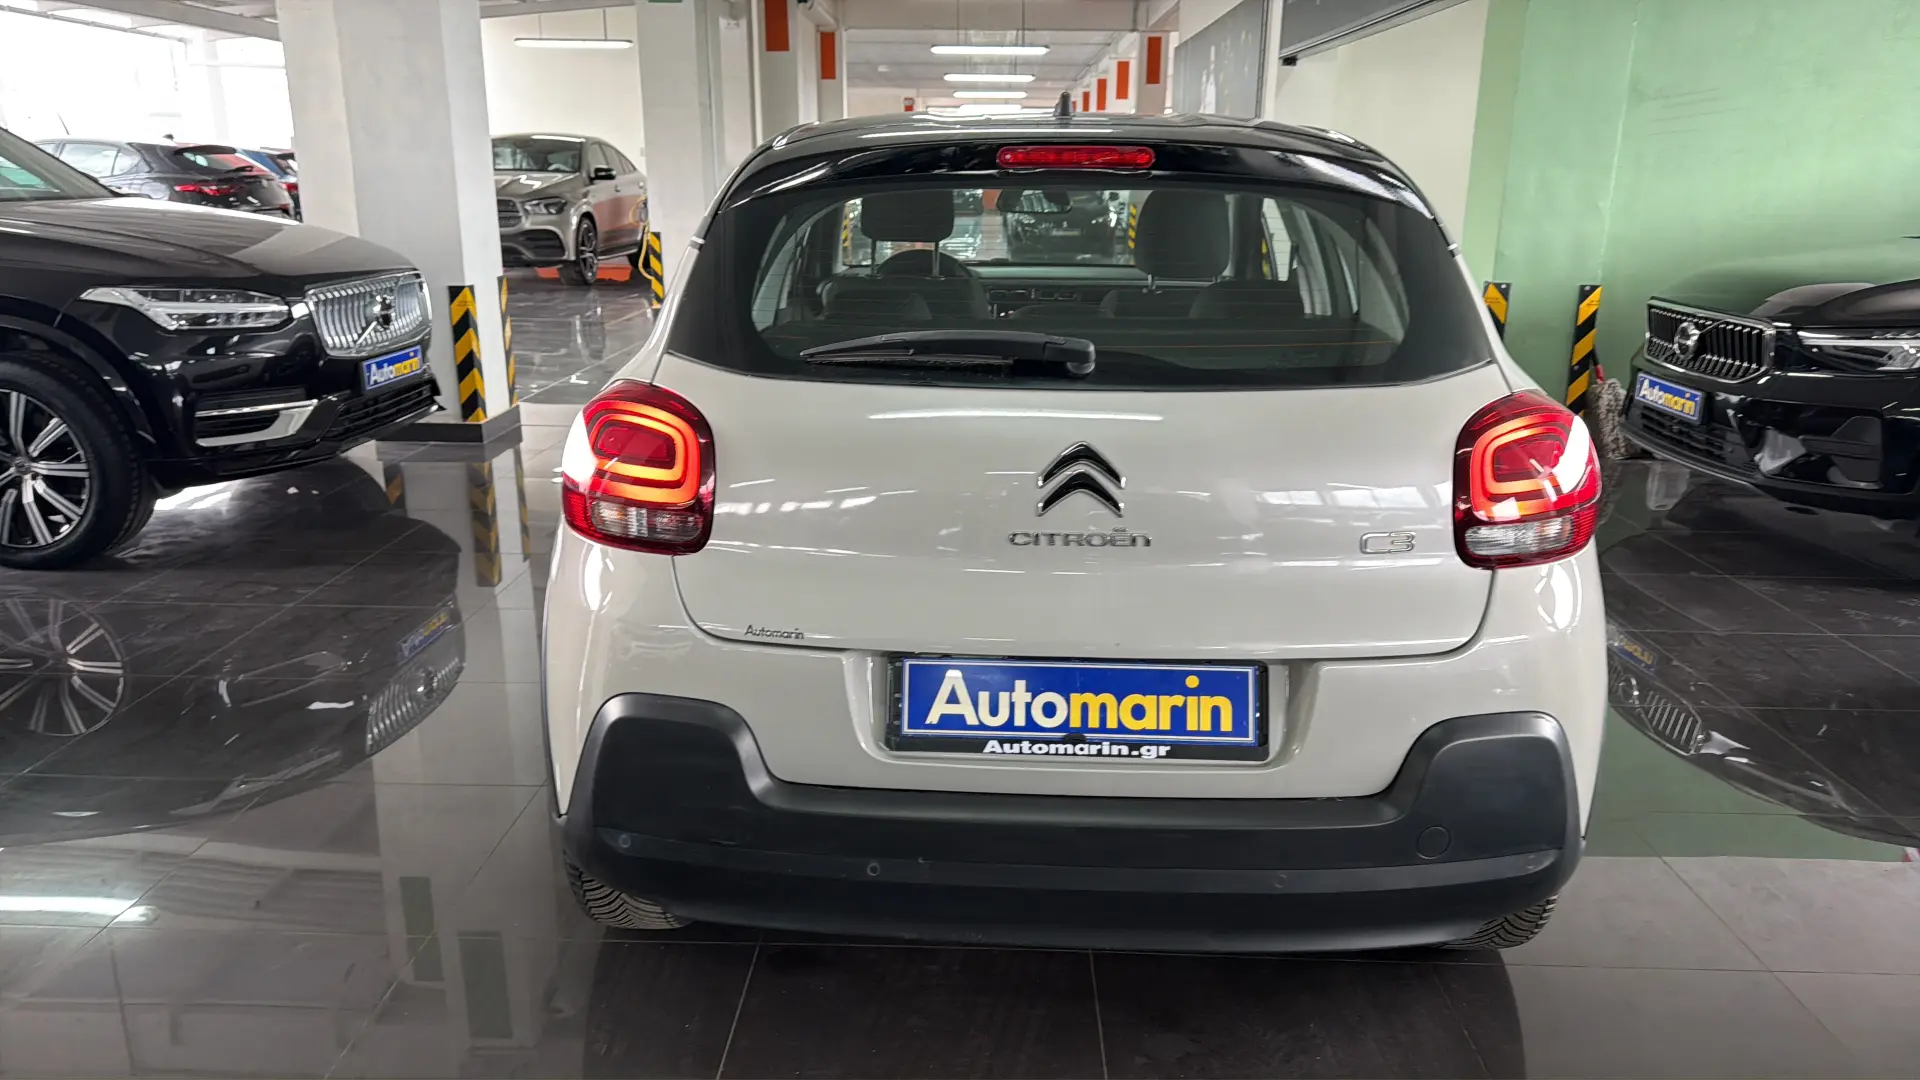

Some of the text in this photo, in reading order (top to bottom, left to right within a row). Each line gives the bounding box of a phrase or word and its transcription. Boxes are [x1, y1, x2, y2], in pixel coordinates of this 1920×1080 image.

[369, 351, 419, 386] Automarin
[1639, 378, 1696, 416] Automarin
[1359, 531, 1415, 555] C3
[744, 624, 805, 640] Automarin
[924, 669, 1234, 732] Automarin
[982, 739, 1172, 759] Automarin.gr
